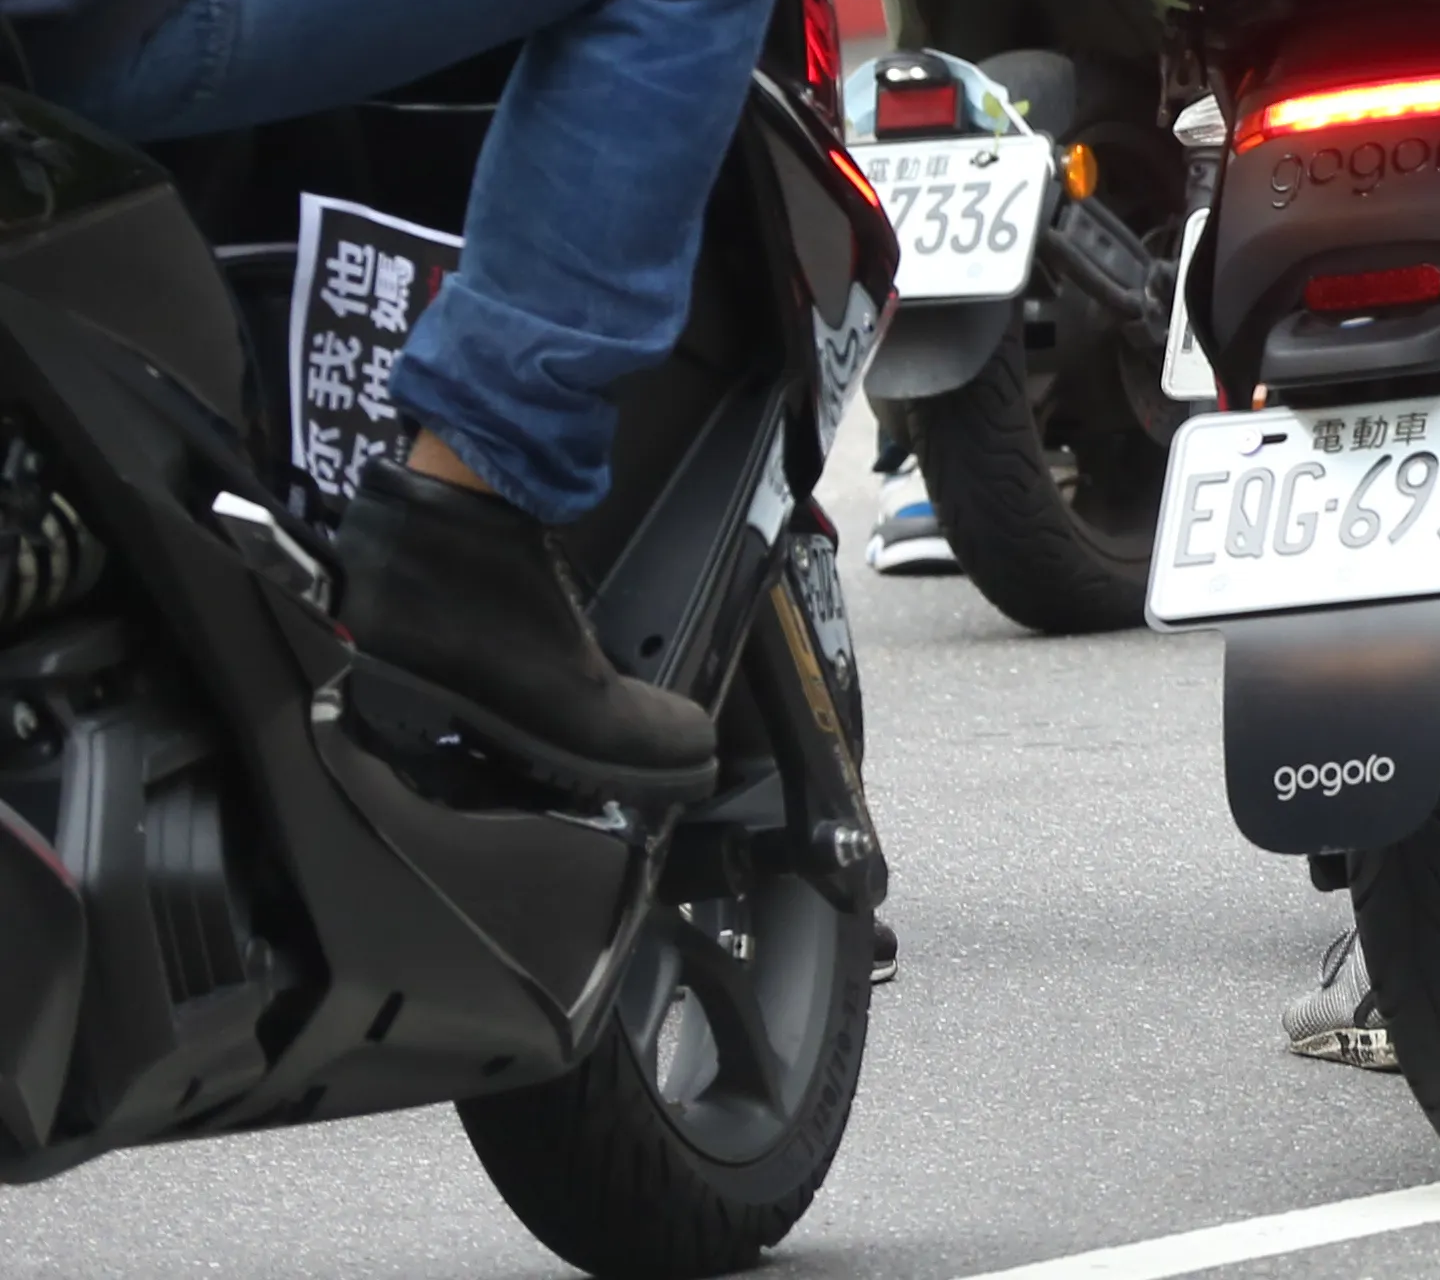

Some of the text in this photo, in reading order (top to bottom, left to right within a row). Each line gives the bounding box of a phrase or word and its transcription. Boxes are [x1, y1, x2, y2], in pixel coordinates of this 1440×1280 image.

[1311, 411, 1430, 454] 電動車
[1273, 753, 1396, 802] gogoro
